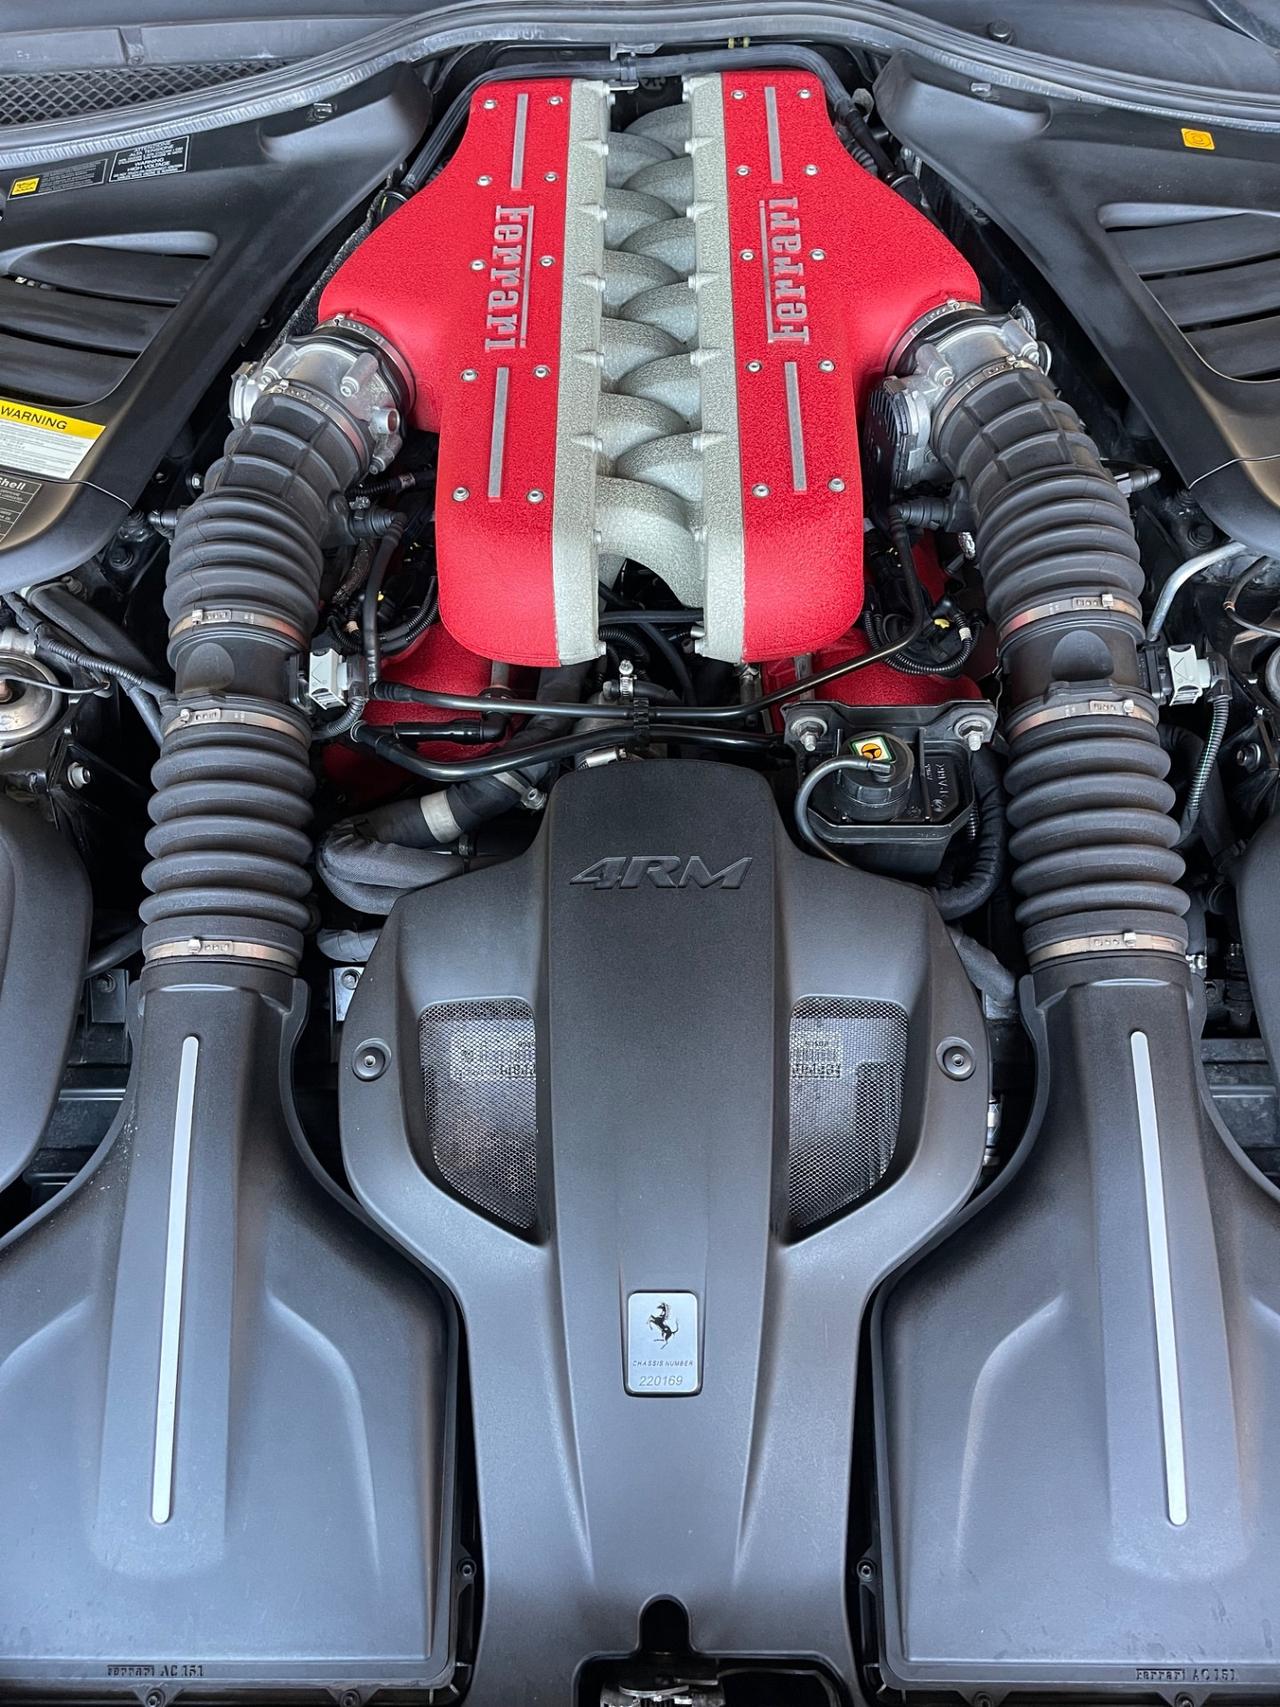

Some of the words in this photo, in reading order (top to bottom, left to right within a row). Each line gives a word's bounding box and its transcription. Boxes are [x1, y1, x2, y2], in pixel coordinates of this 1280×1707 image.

[485, 205, 535, 352] Ferrari
[758, 197, 810, 345] Ferrari
[1, 405, 68, 430] WARNING
[570, 855, 753, 889] 4RM
[639, 1375, 684, 1386] 220169
[107, 1664, 155, 1677] Ferrari
[160, 1664, 178, 1677] AC
[182, 1664, 205, 1677] 151
[1136, 1668, 1186, 1680] Ferrari
[1193, 1668, 1210, 1680] AC
[1214, 1668, 1235, 1680] 151
